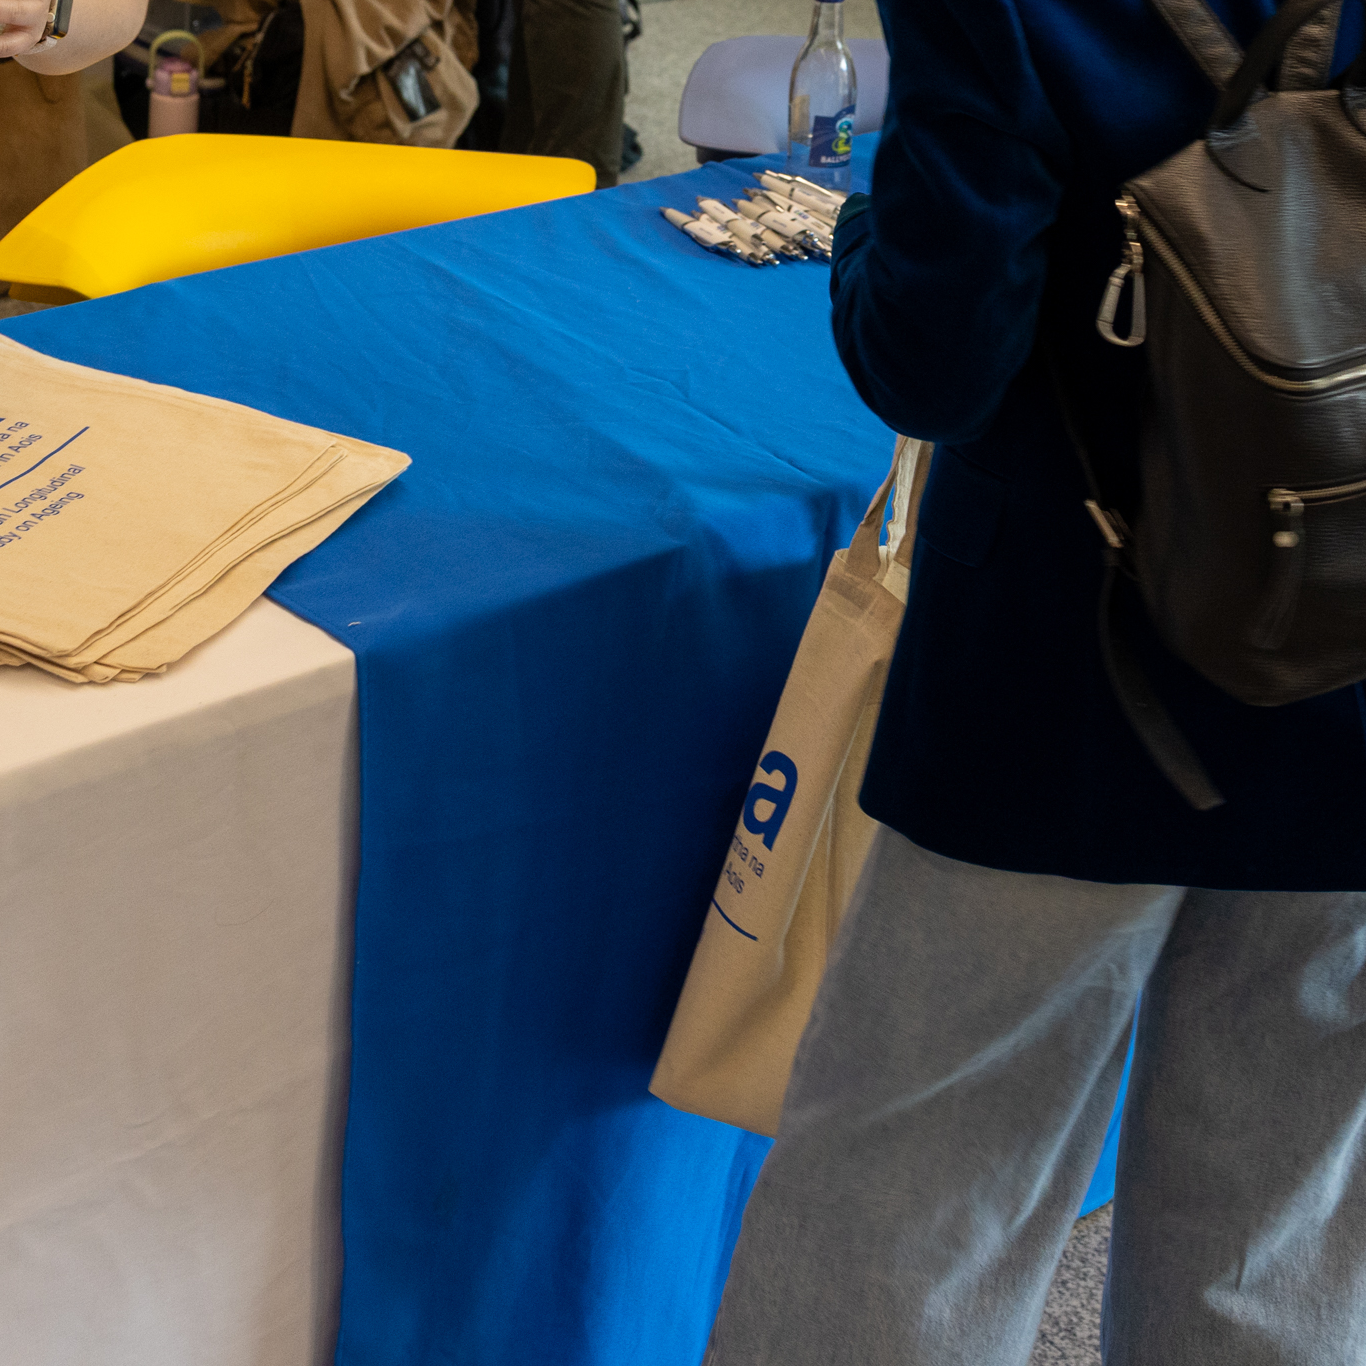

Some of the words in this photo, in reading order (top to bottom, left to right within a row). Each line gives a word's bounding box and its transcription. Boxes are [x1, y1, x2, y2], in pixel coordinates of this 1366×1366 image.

[7, 420, 30, 440] na
[8, 431, 43, 457] Aois
[6, 464, 86, 515] Longitudinal
[15, 517, 38, 536] on
[32, 489, 85, 525] Ageing
